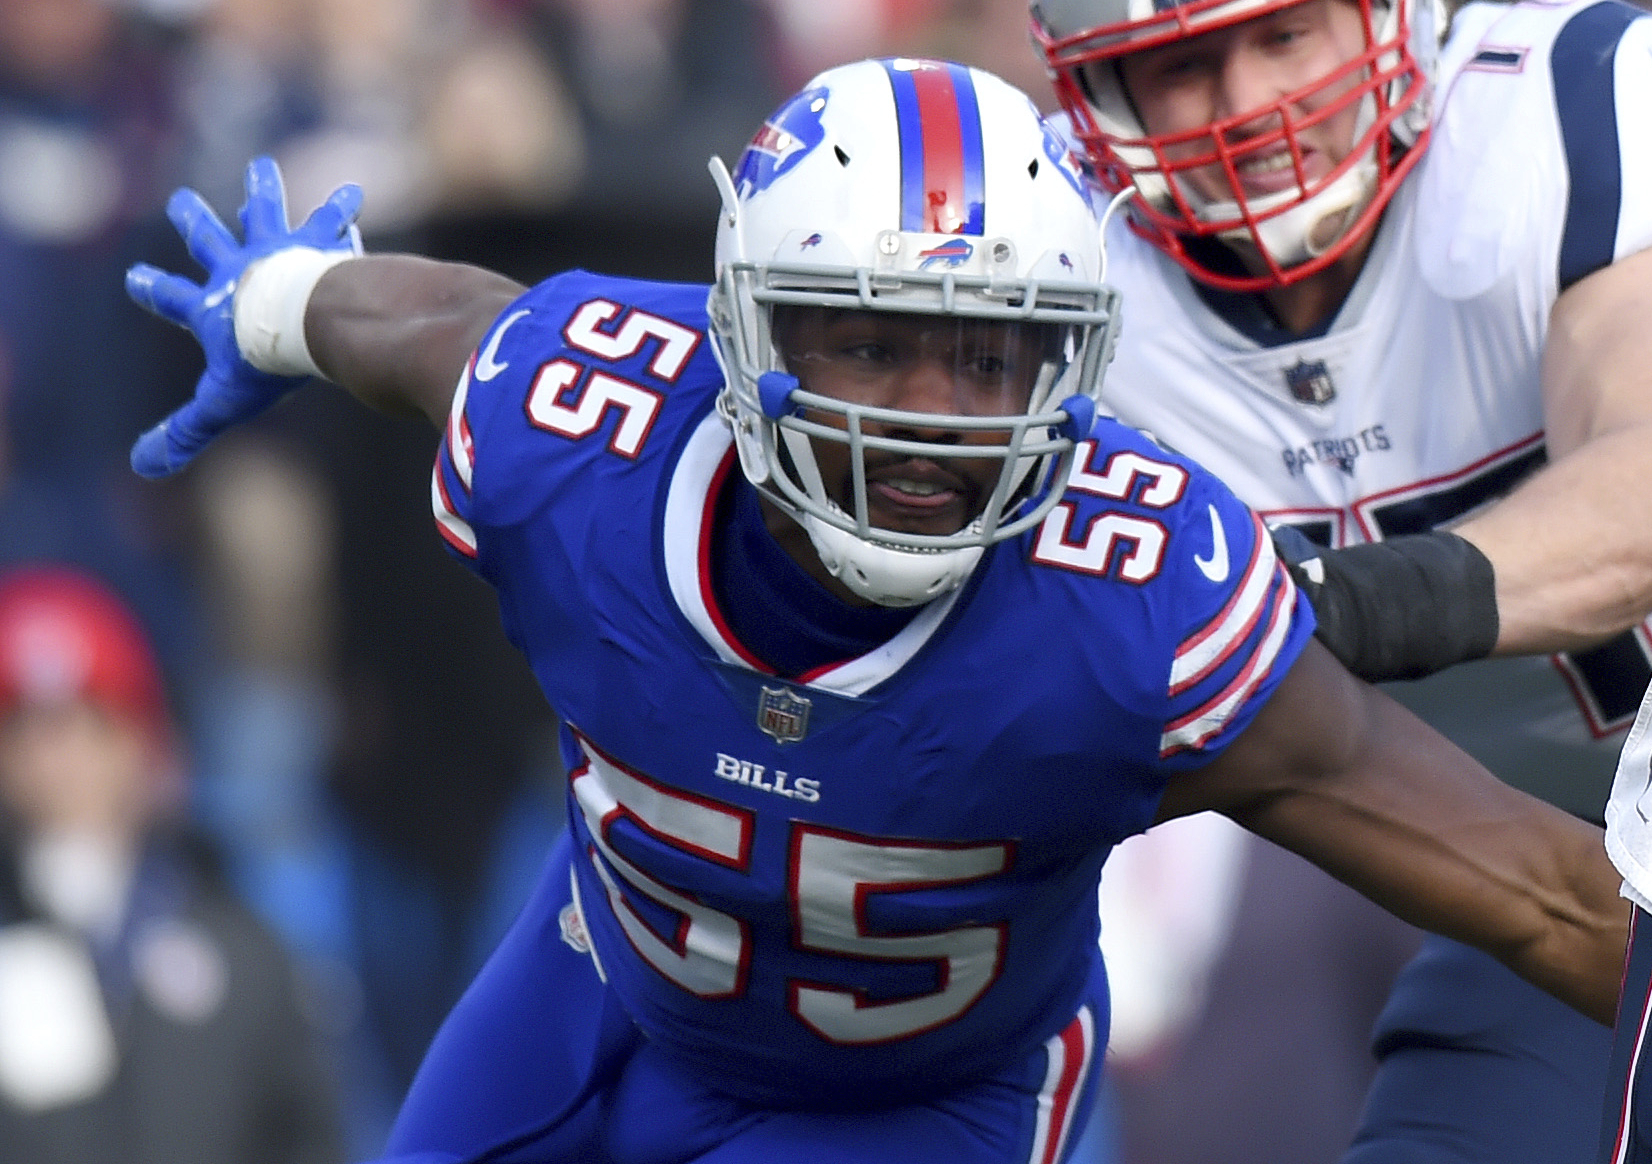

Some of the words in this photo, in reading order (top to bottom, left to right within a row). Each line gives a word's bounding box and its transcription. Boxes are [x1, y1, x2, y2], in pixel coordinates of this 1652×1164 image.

[524, 296, 704, 462] 55
[1031, 438, 1190, 585] 55
[714, 752, 821, 803] BILLS
[765, 709, 801, 737] NFL
[566, 720, 1022, 1048] 55
